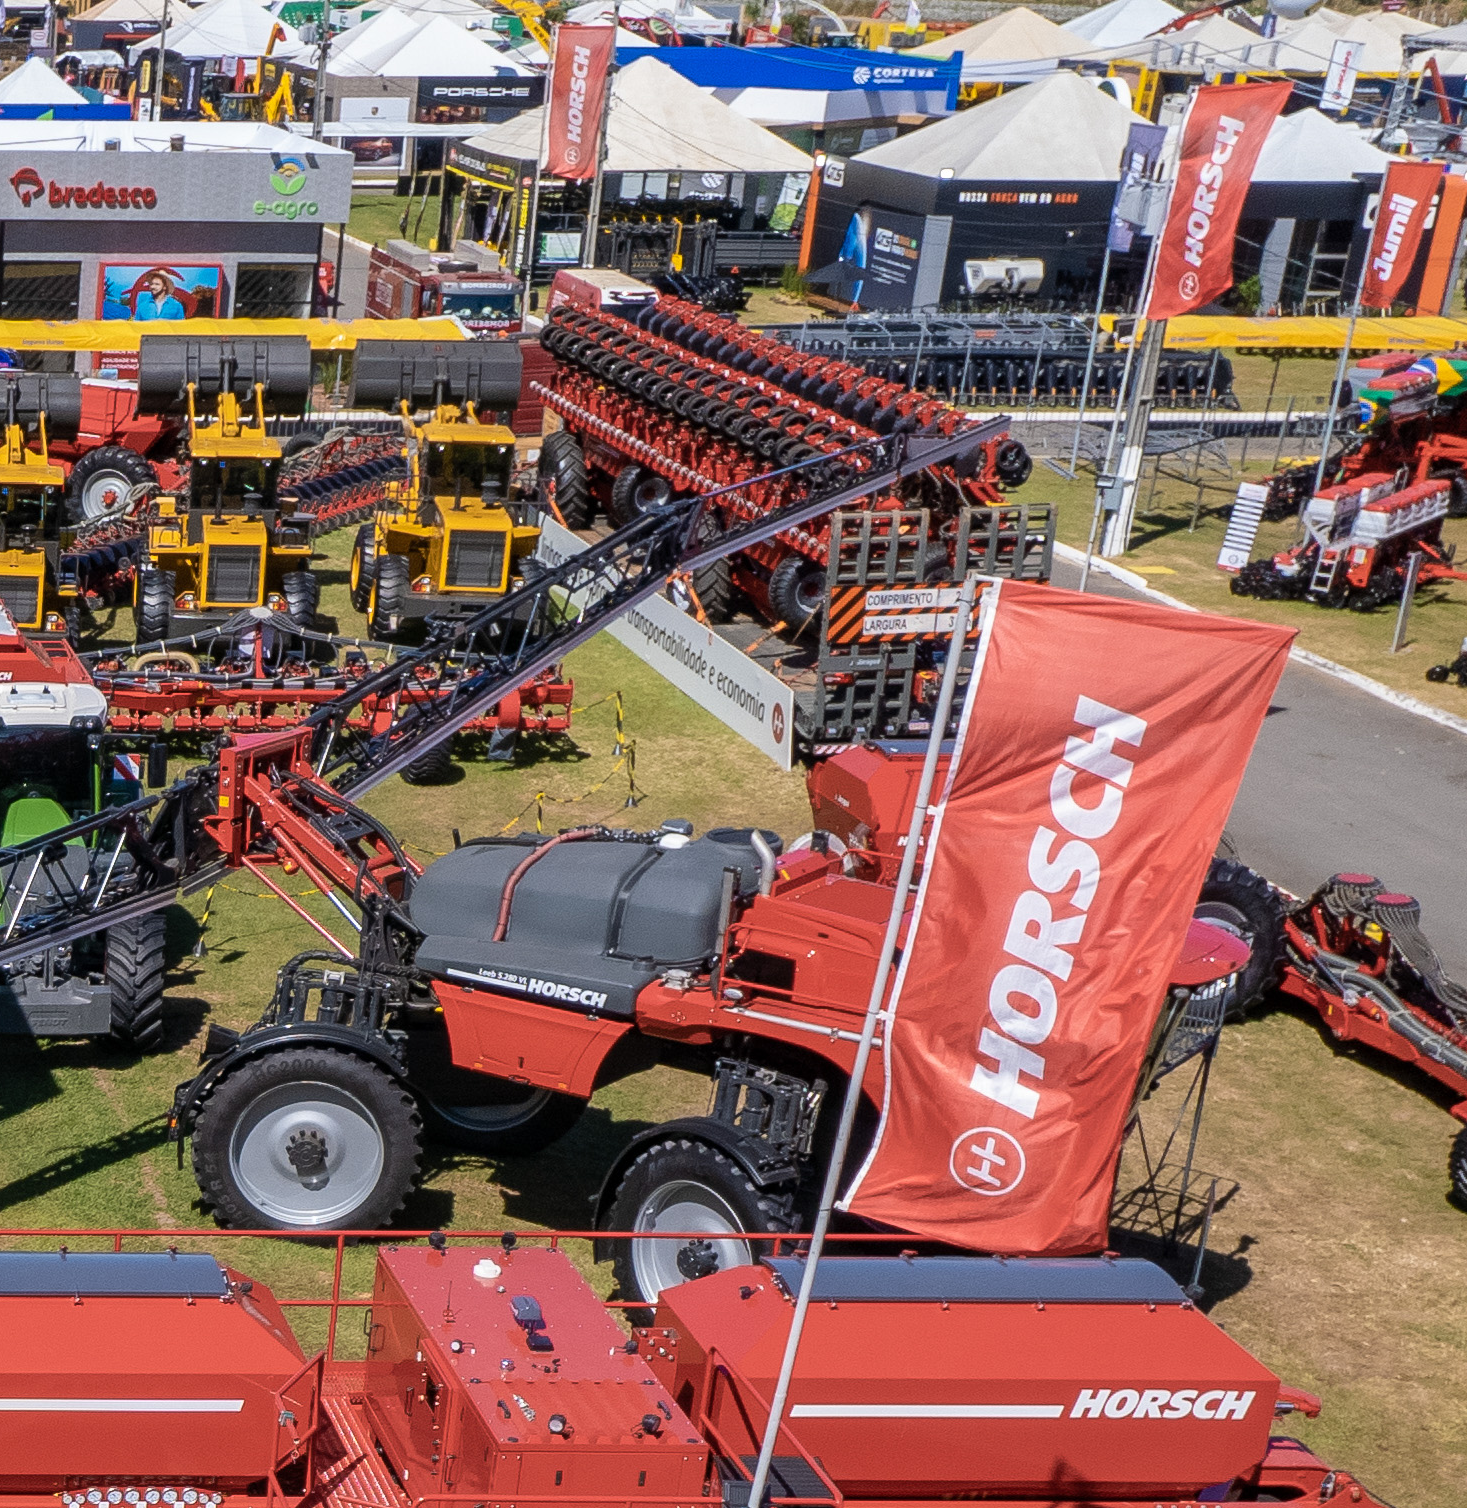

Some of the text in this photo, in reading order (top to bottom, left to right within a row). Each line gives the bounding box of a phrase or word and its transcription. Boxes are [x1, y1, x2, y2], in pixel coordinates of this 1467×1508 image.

[433, 87, 530, 97] PORSCHE
[566, 45, 592, 143] HORSCH
[48, 179, 158, 209] bradesco
[1183, 115, 1246, 267] HORSCH
[253, 201, 319, 220] e-agro
[1372, 194, 1418, 282] Jumil
[867, 593, 933, 606] COMPRIMENTO
[865, 619, 907, 631] LARGURA
[717, 673, 766, 723] economia
[970, 695, 1147, 1120] HORSCH
[527, 977, 607, 1009] HORSCH
[1070, 1388, 1256, 1421] HORSCH
